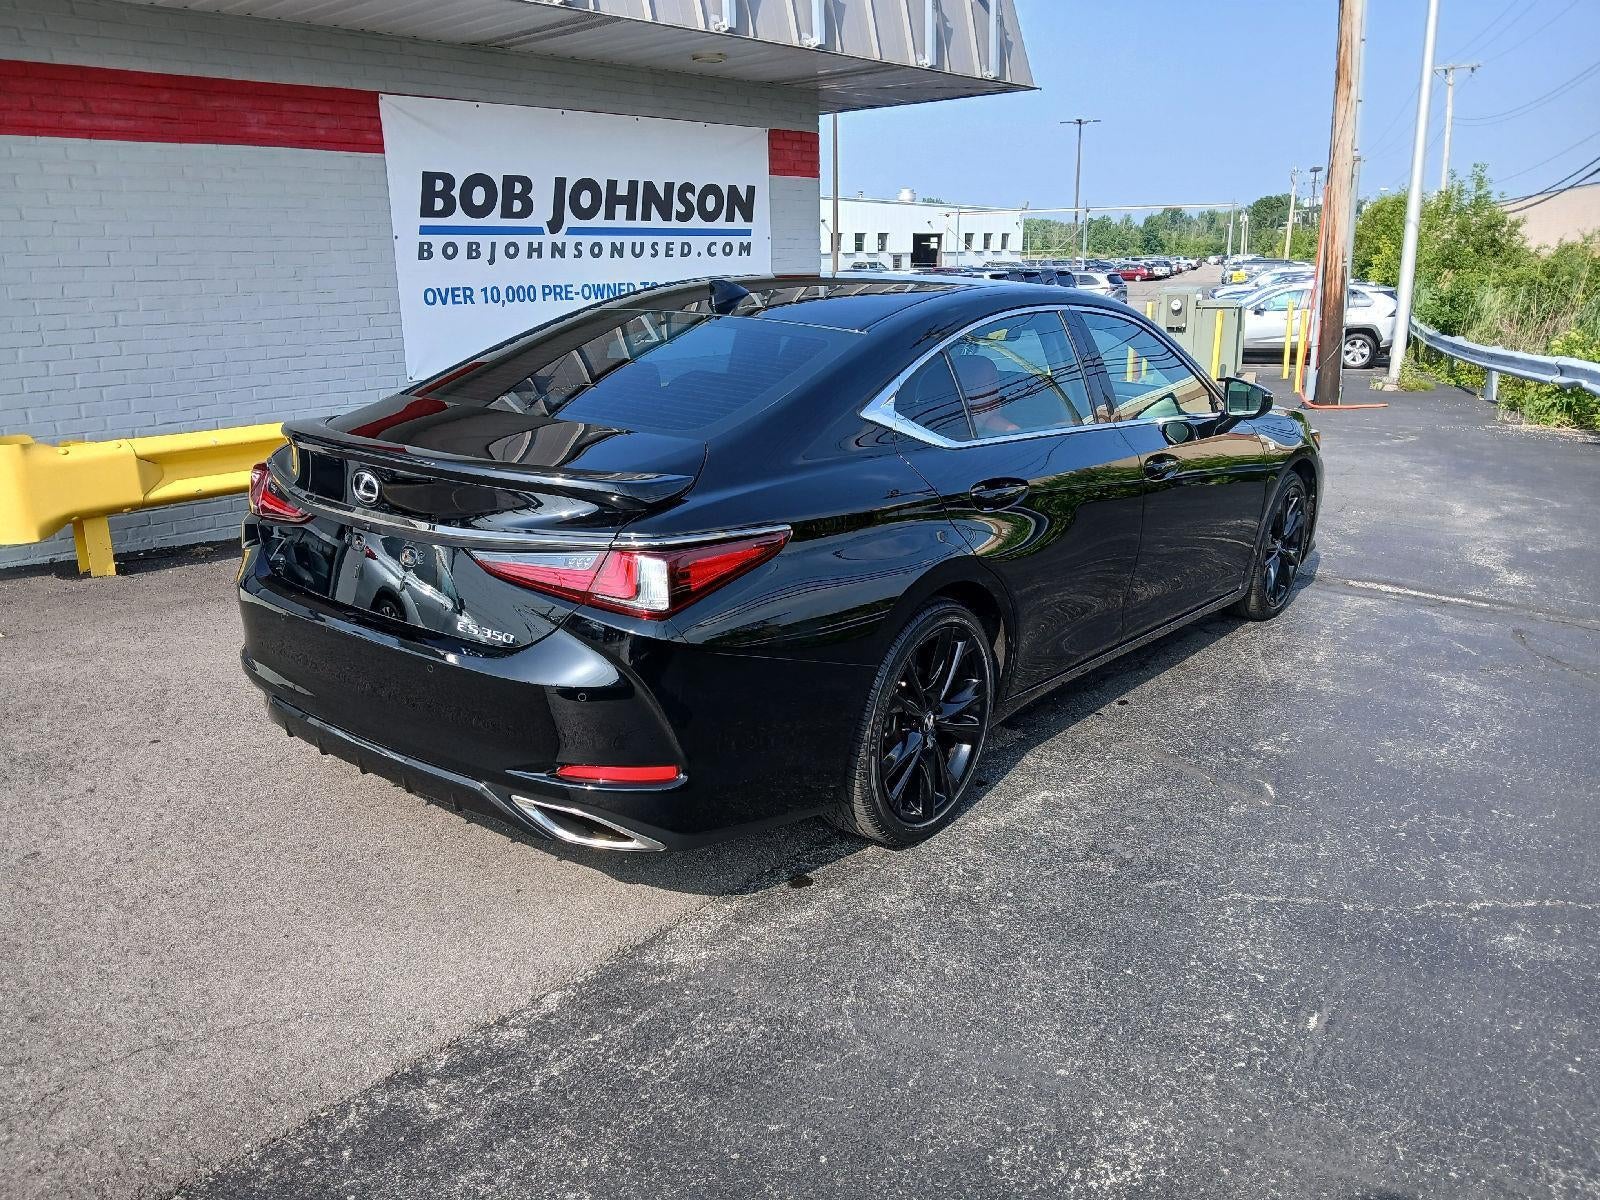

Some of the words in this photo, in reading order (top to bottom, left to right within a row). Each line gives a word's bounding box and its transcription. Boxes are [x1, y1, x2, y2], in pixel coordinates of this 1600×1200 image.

[420, 171, 534, 219] BOB
[546, 177, 755, 234] JOHNSON
[418, 241, 752, 265] BOBJOHNSONUSED.COM
[424, 286, 475, 306] OVER
[480, 284, 537, 307] 10,000
